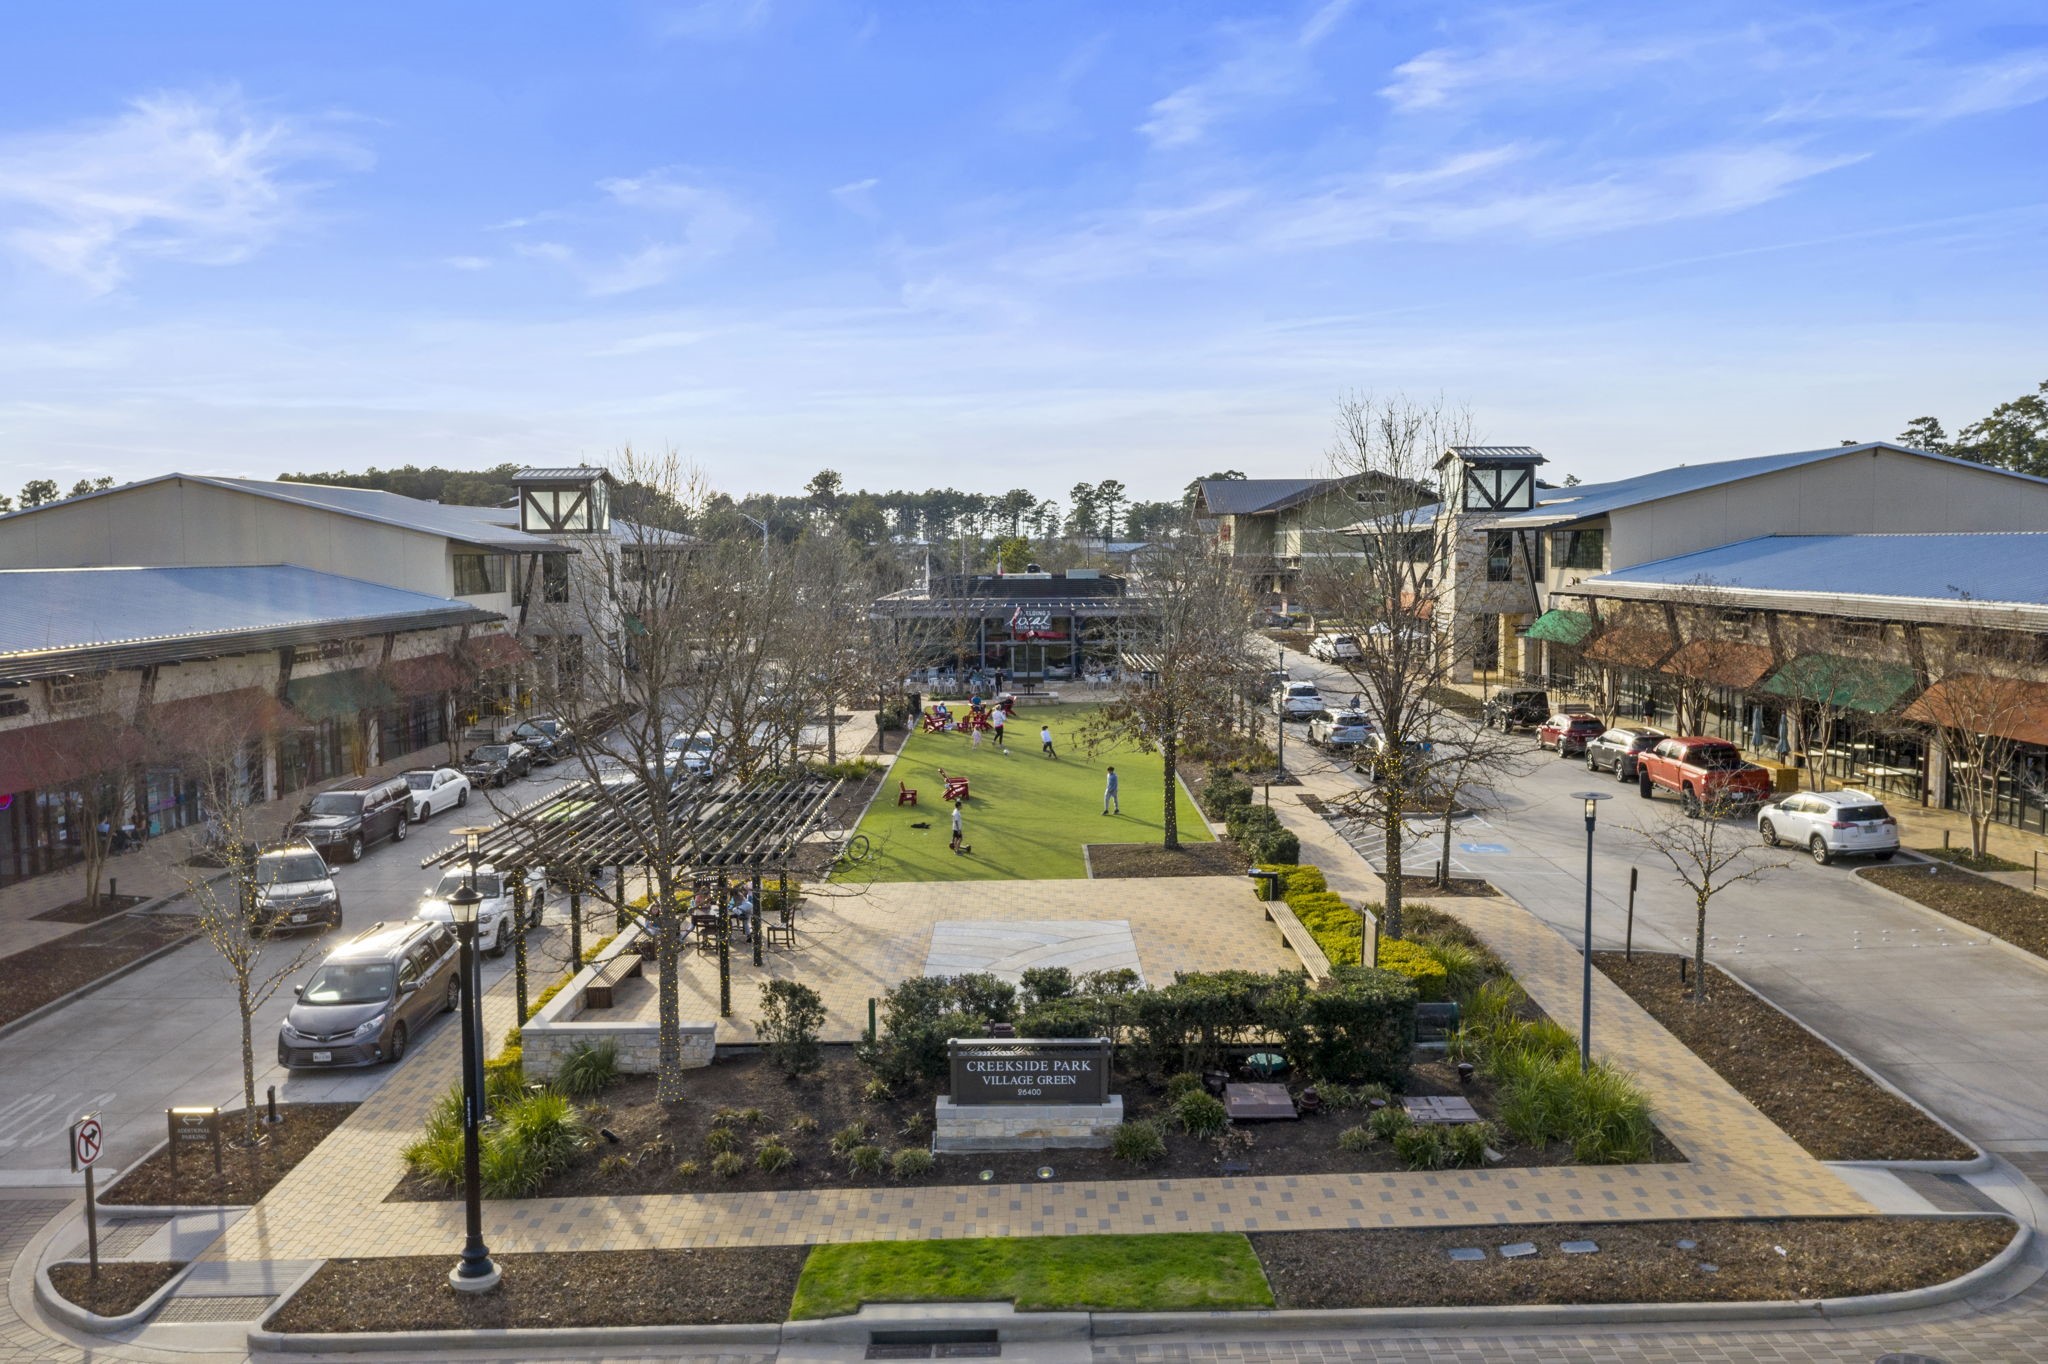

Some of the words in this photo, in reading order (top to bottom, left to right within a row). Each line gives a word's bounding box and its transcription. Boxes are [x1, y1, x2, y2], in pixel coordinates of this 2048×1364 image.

[966, 1060, 1049, 1072] CREEKSIDE
[1053, 1060, 1091, 1071] PARK
[982, 1075, 1034, 1085] VILLAGE
[1037, 1075, 1077, 1085] GREEN
[1017, 1088, 1042, 1096] 26400
